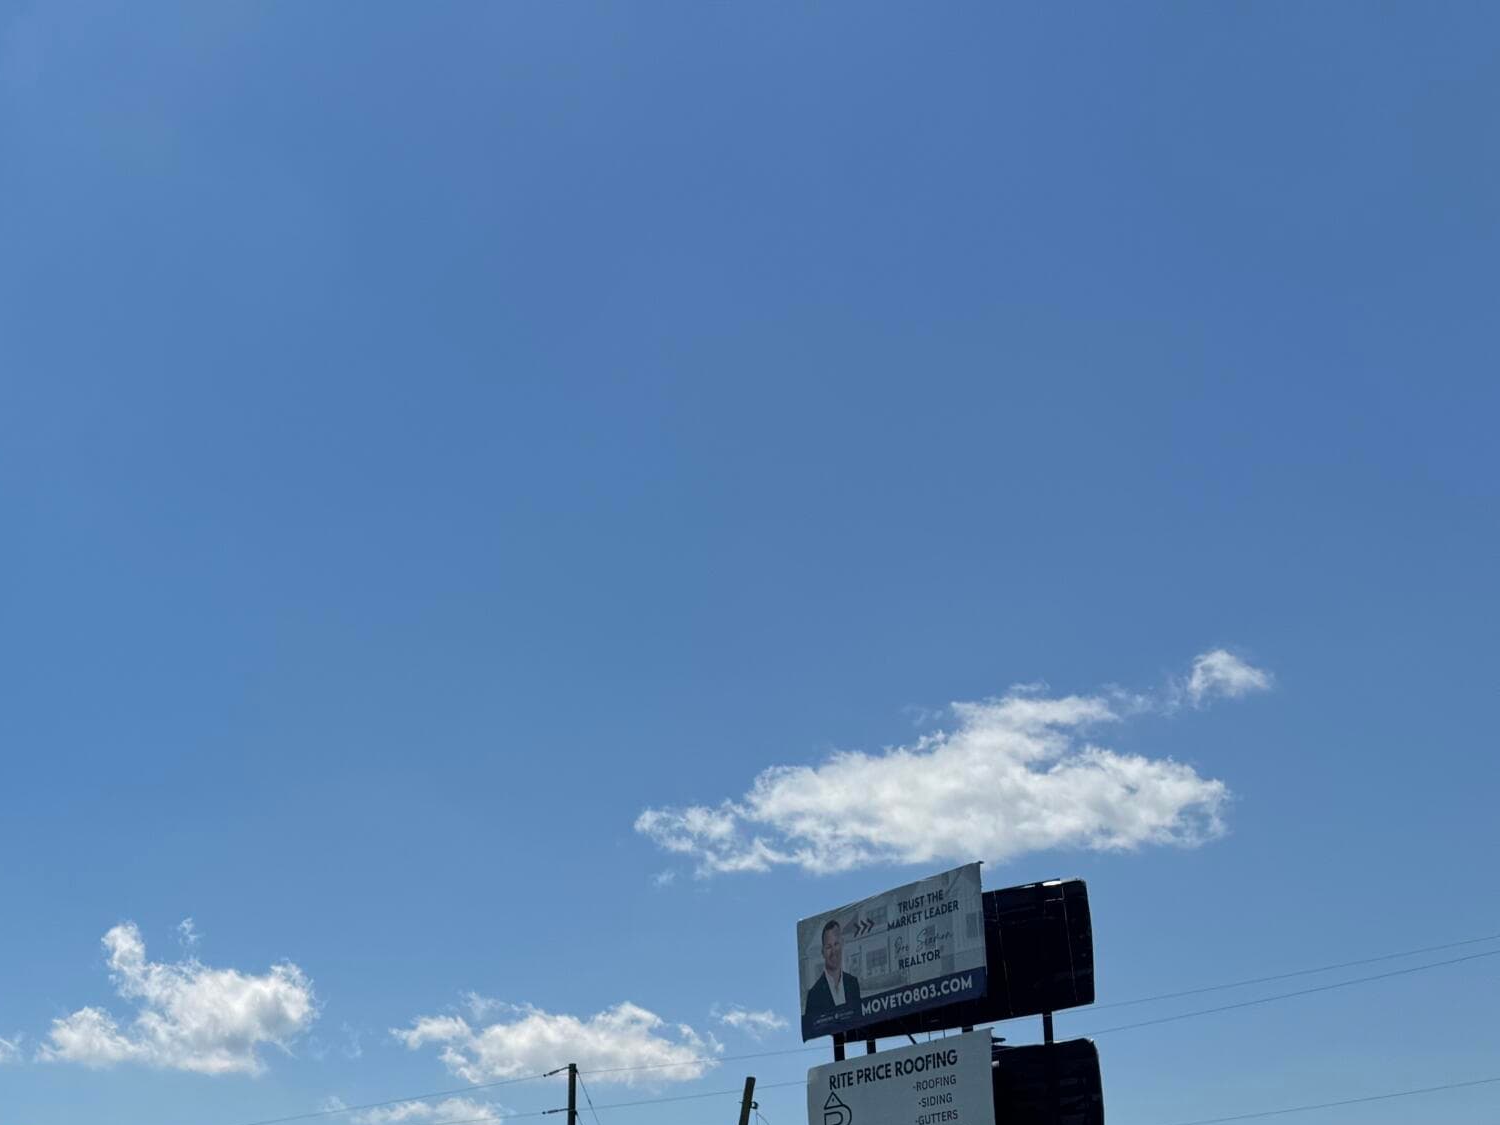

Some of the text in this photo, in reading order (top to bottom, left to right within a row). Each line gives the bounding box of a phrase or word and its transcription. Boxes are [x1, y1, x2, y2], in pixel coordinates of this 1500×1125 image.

[887, 900, 959, 931] MARKET LEADER
[898, 890, 943, 913] TRUST THE
[898, 949, 941, 970] REALTOR
[861, 975, 973, 1017] MOVETO803.COM
[829, 1049, 958, 1090] RITE PRICE ROOFING
